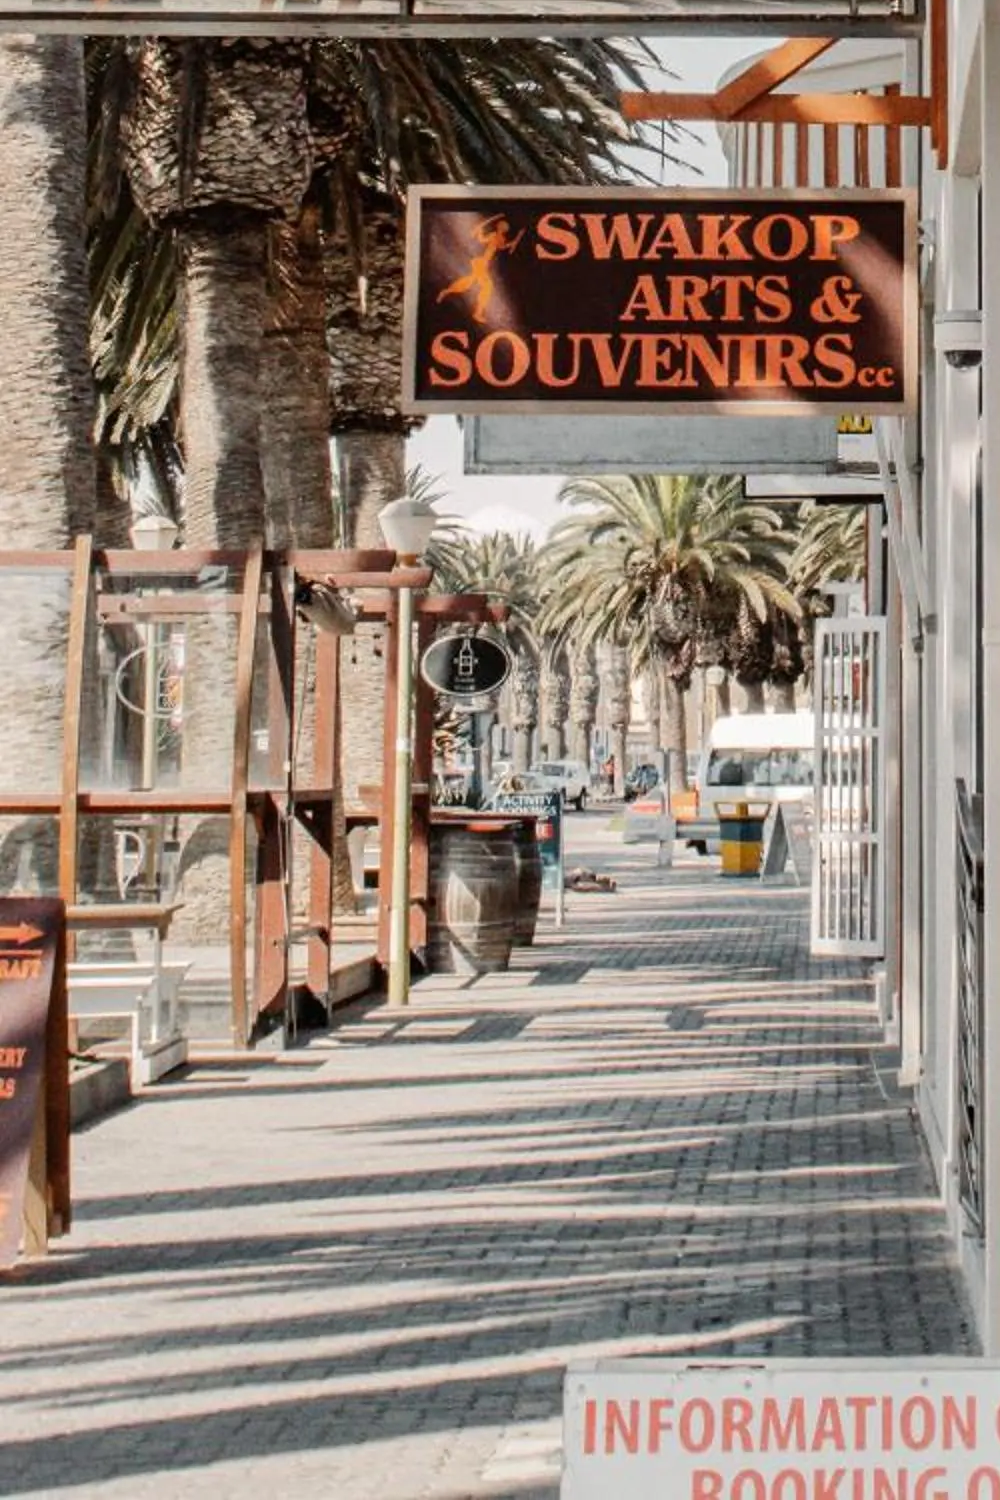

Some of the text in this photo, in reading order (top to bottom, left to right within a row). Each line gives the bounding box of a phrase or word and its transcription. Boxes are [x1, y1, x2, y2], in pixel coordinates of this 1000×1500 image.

[535, 212, 861, 262] SWAKOP
[619, 274, 862, 324] ARTS &
[428, 330, 857, 388] SOUVENIRS
[582, 1394, 978, 1454] INFORMATION
